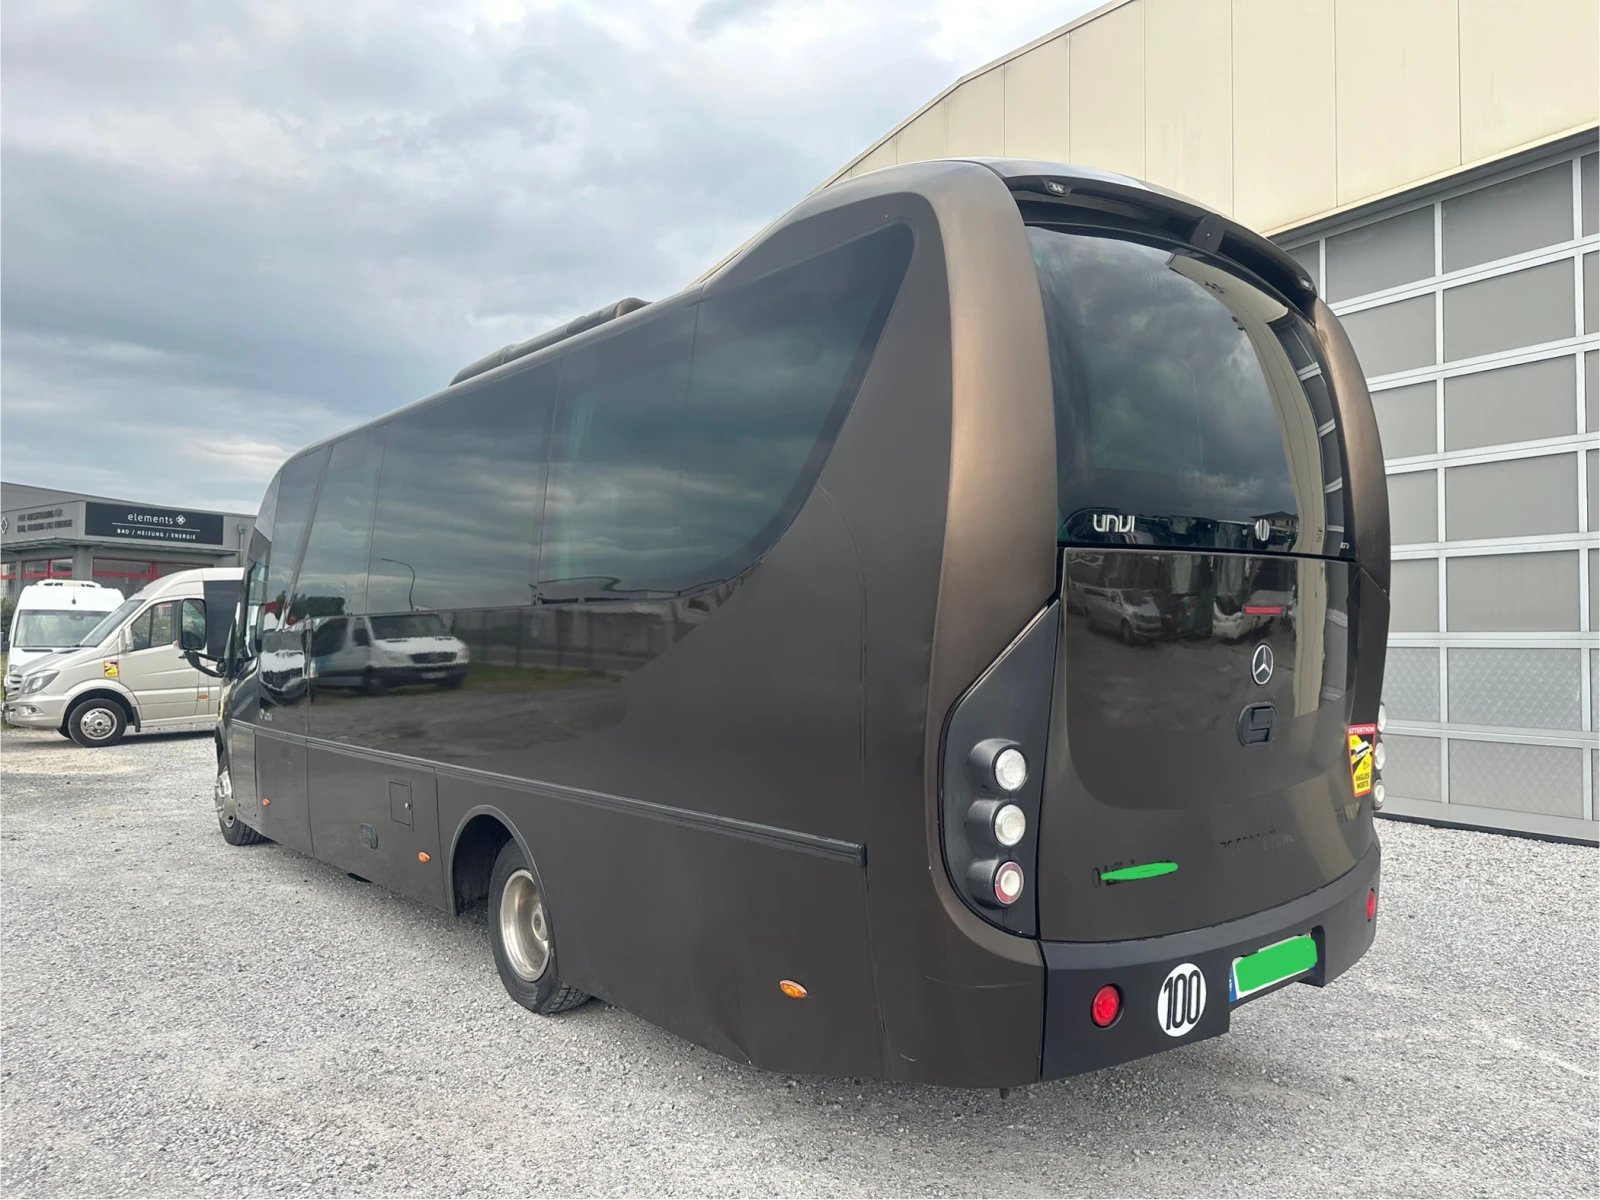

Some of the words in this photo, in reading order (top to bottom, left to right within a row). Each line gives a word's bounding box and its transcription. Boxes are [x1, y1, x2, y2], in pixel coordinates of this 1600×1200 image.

[127, 512, 174, 525] elements
[136, 530, 164, 538] HEIZUNG
[170, 532, 197, 541] ENERGIE
[1348, 726, 1375, 735] ATTENTION
[1355, 772, 1370, 782] ANGLES
[1356, 780, 1369, 790] MORTS
[1163, 969, 1201, 1031] 100
